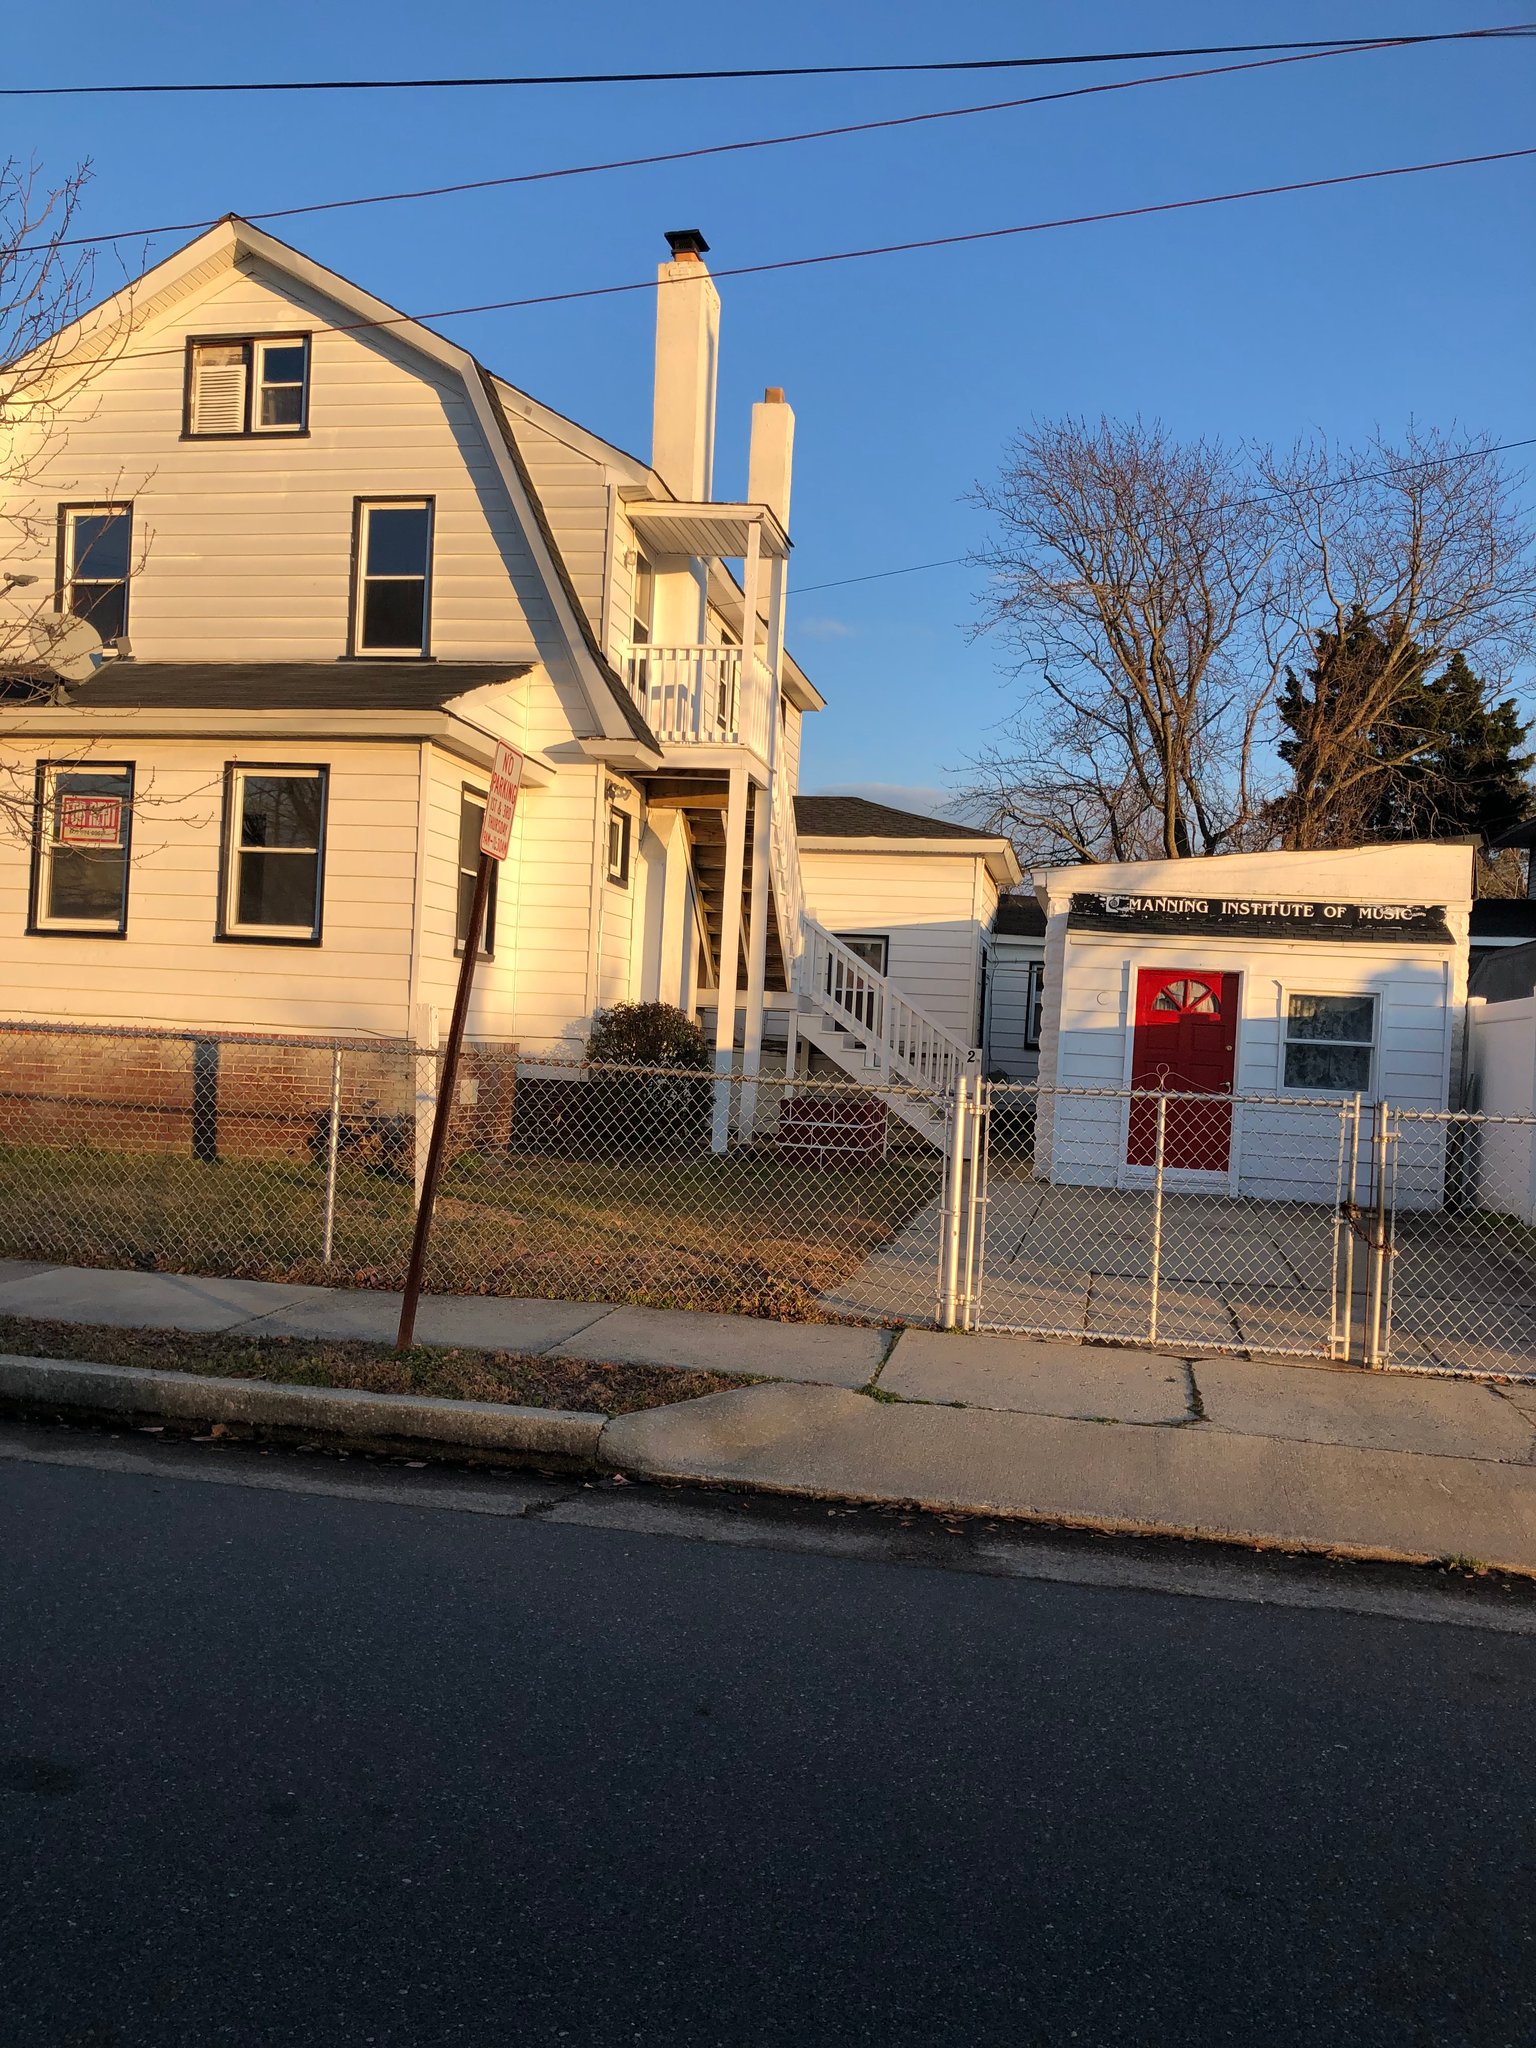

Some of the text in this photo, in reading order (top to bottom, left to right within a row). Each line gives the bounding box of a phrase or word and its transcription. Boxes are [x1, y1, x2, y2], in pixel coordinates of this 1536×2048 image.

[502, 752, 515, 776] NO
[491, 772, 519, 805] PARKING
[65, 800, 117, 827] FOR RENT
[502, 804, 512, 820] 3RD
[488, 814, 509, 837] THURSDAY
[1129, 897, 1413, 921] MANNING INSTITUTE OF MUSIC
[967, 1050, 976, 1063] 2
